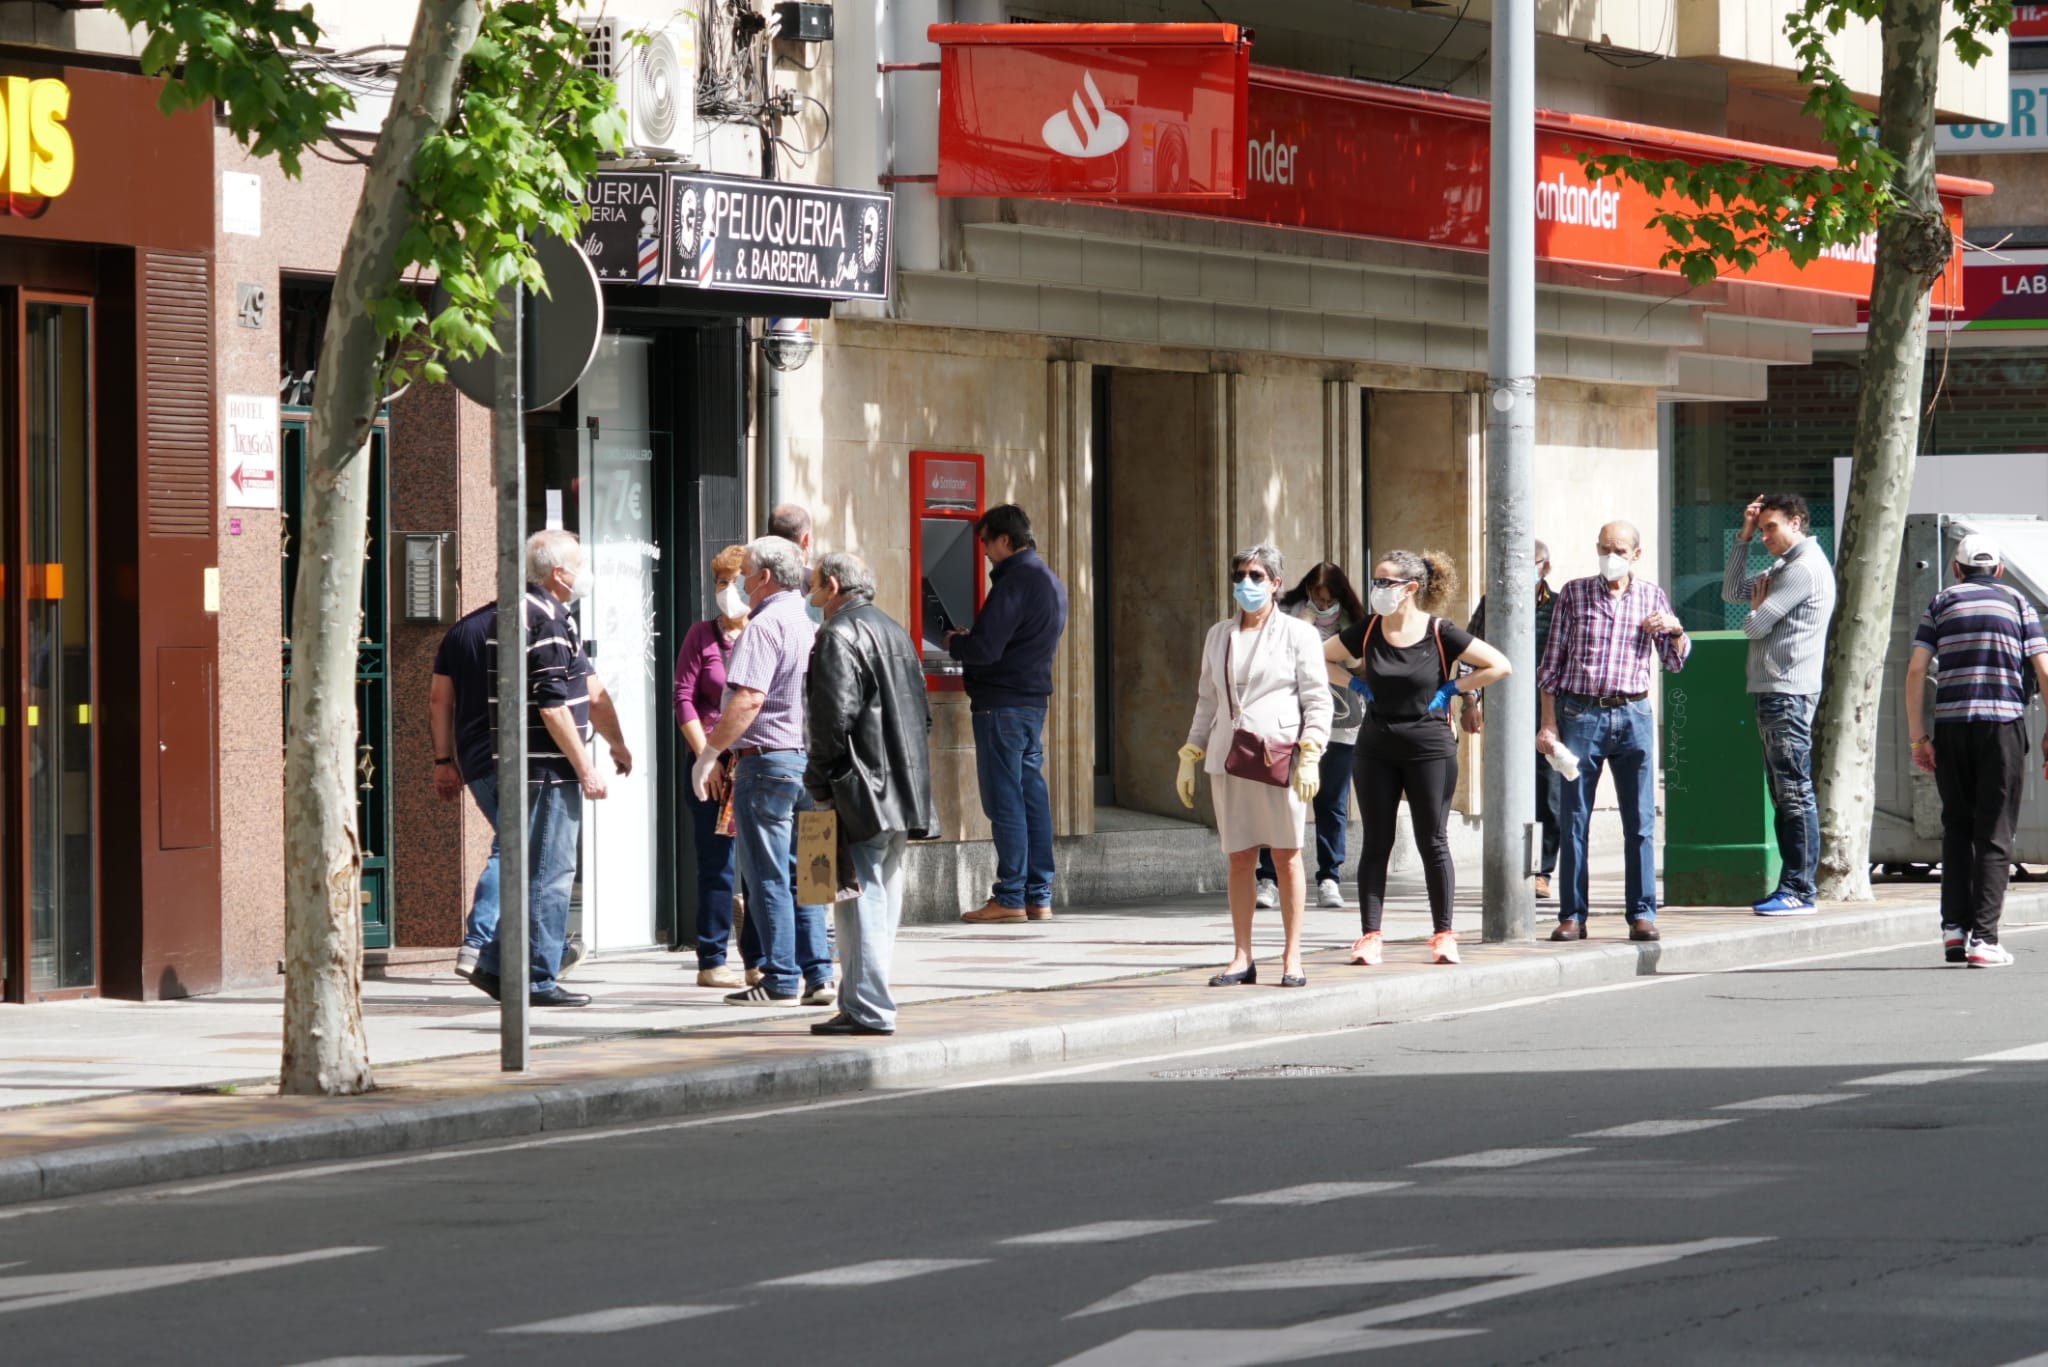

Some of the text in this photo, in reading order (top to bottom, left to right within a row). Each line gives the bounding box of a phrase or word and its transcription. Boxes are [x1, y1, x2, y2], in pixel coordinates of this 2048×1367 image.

[0, 76, 74, 197] IS
[715, 190, 846, 249] PELUQUERIA
[735, 248, 819, 284] & BARBERIA
[2002, 275, 2048, 295] LAB
[238, 284, 264, 327] 49
[229, 401, 265, 419] HOTEL
[614, 470, 642, 521] 7€
